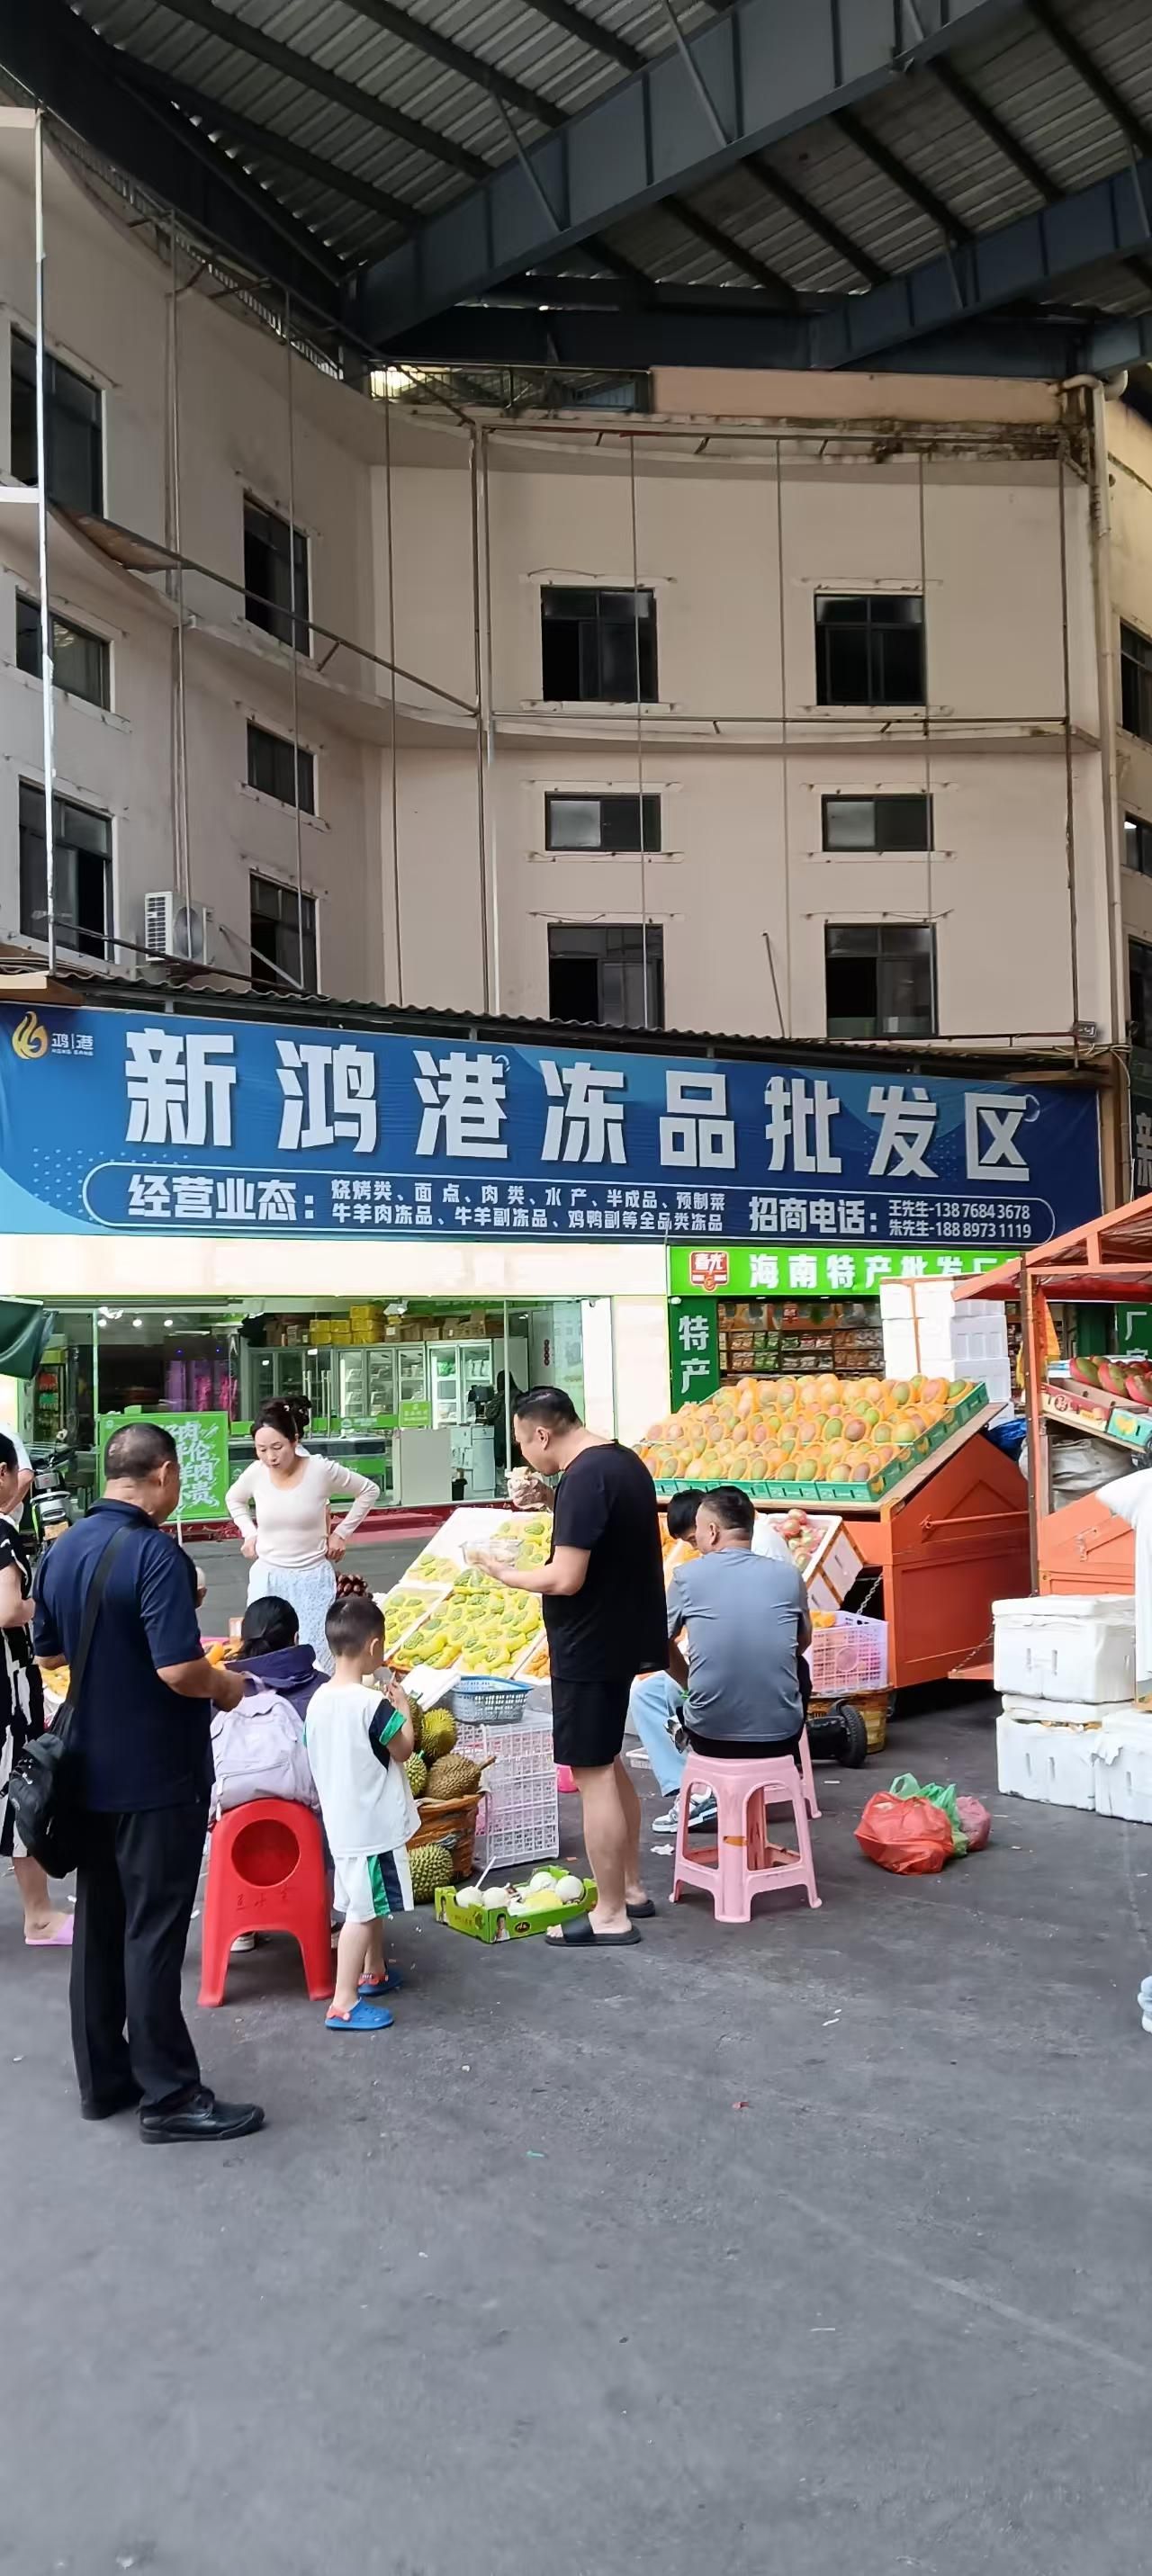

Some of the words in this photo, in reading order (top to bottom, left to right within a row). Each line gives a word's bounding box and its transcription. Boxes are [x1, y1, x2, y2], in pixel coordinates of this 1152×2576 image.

[125, 1028, 1030, 1181] 新鸿港冻品批发区
[750, 1253, 1021, 1289] 海南特产批发厂
[679, 1315, 710, 1405] 特产
